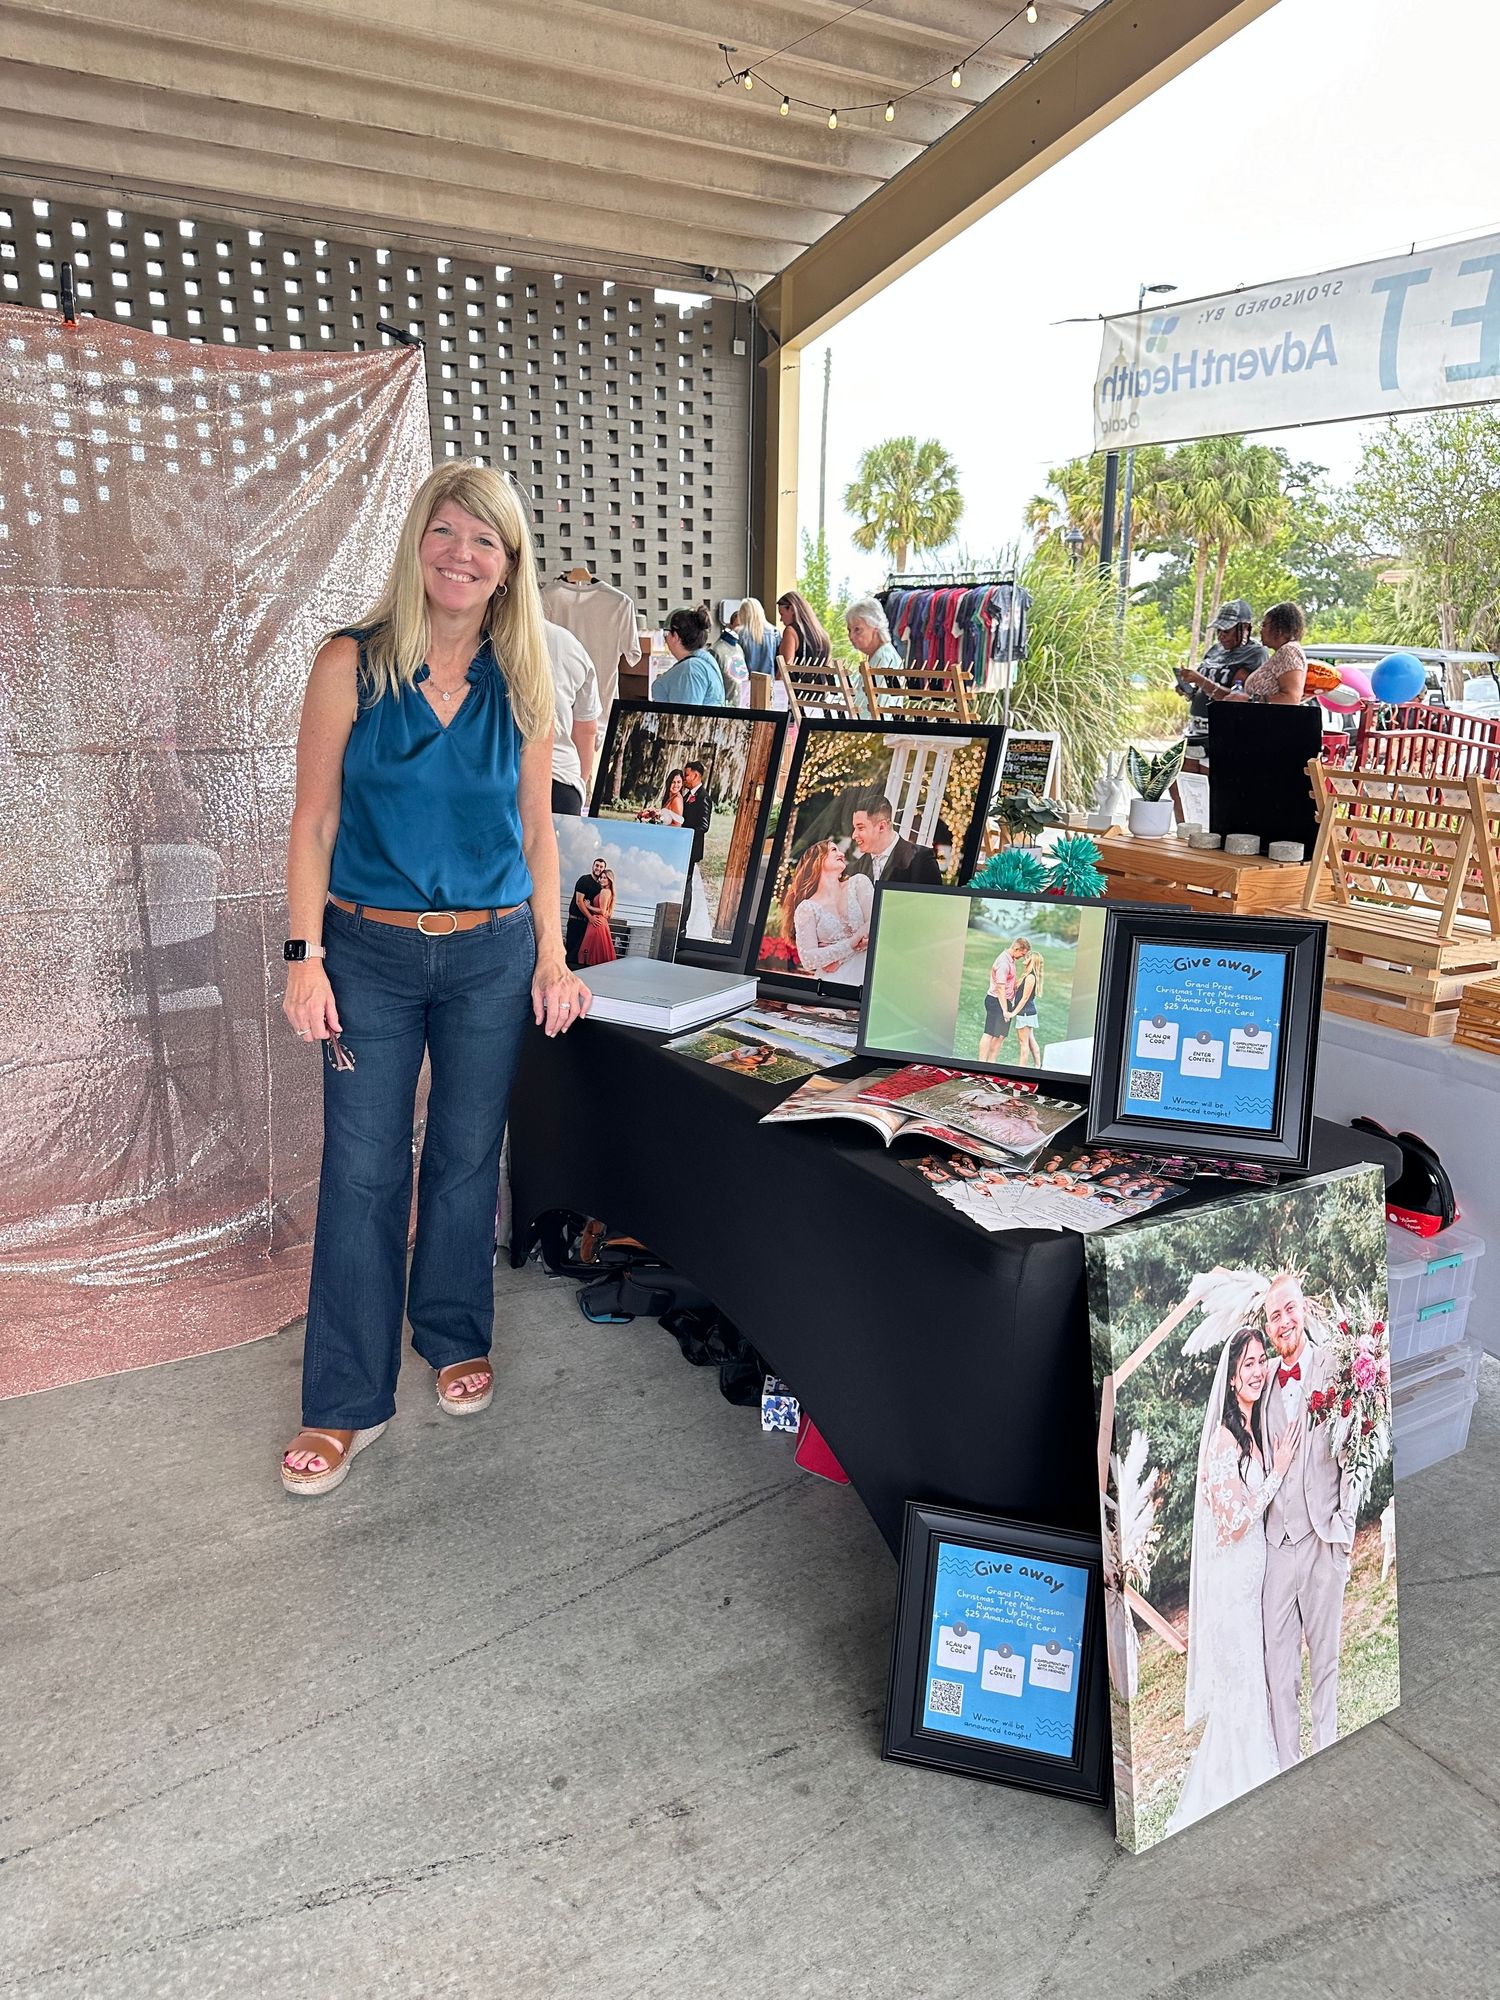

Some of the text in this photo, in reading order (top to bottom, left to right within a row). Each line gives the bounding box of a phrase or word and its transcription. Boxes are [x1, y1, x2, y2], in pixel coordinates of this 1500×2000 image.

[1173, 955, 1262, 981] Give away
[1156, 985, 1263, 1001] Christmas Tree Mini-session
[1185, 980, 1233, 991] Grand Prize
[1175, 995, 1240, 1008] Runner Up Prize
[1164, 1002, 1255, 1017] $25 Amazon Gift Card
[1188, 1055, 1215, 1063] CONTEST
[1172, 1096, 1224, 1109] Winner will be
[1163, 1104, 1231, 1119] announced tonight!
[974, 1559, 1065, 1594] Give away
[986, 1586, 1036, 1602] Grand Prize
[956, 1588, 1065, 1617] Christmas Tree Mini-session
[976, 1602, 1042, 1622] Runner Up Prize
[965, 1609, 1057, 1633] $25 Amazon Gift Card
[945, 1640, 962, 1648] SCAN
[950, 1647, 966, 1655] CODE
[989, 1670, 1017, 1680] CONTEST
[994, 1665, 1013, 1673] ENTER
[972, 1712, 1025, 1731] Winner will be
[963, 1720, 1032, 1741] announced tonight!
